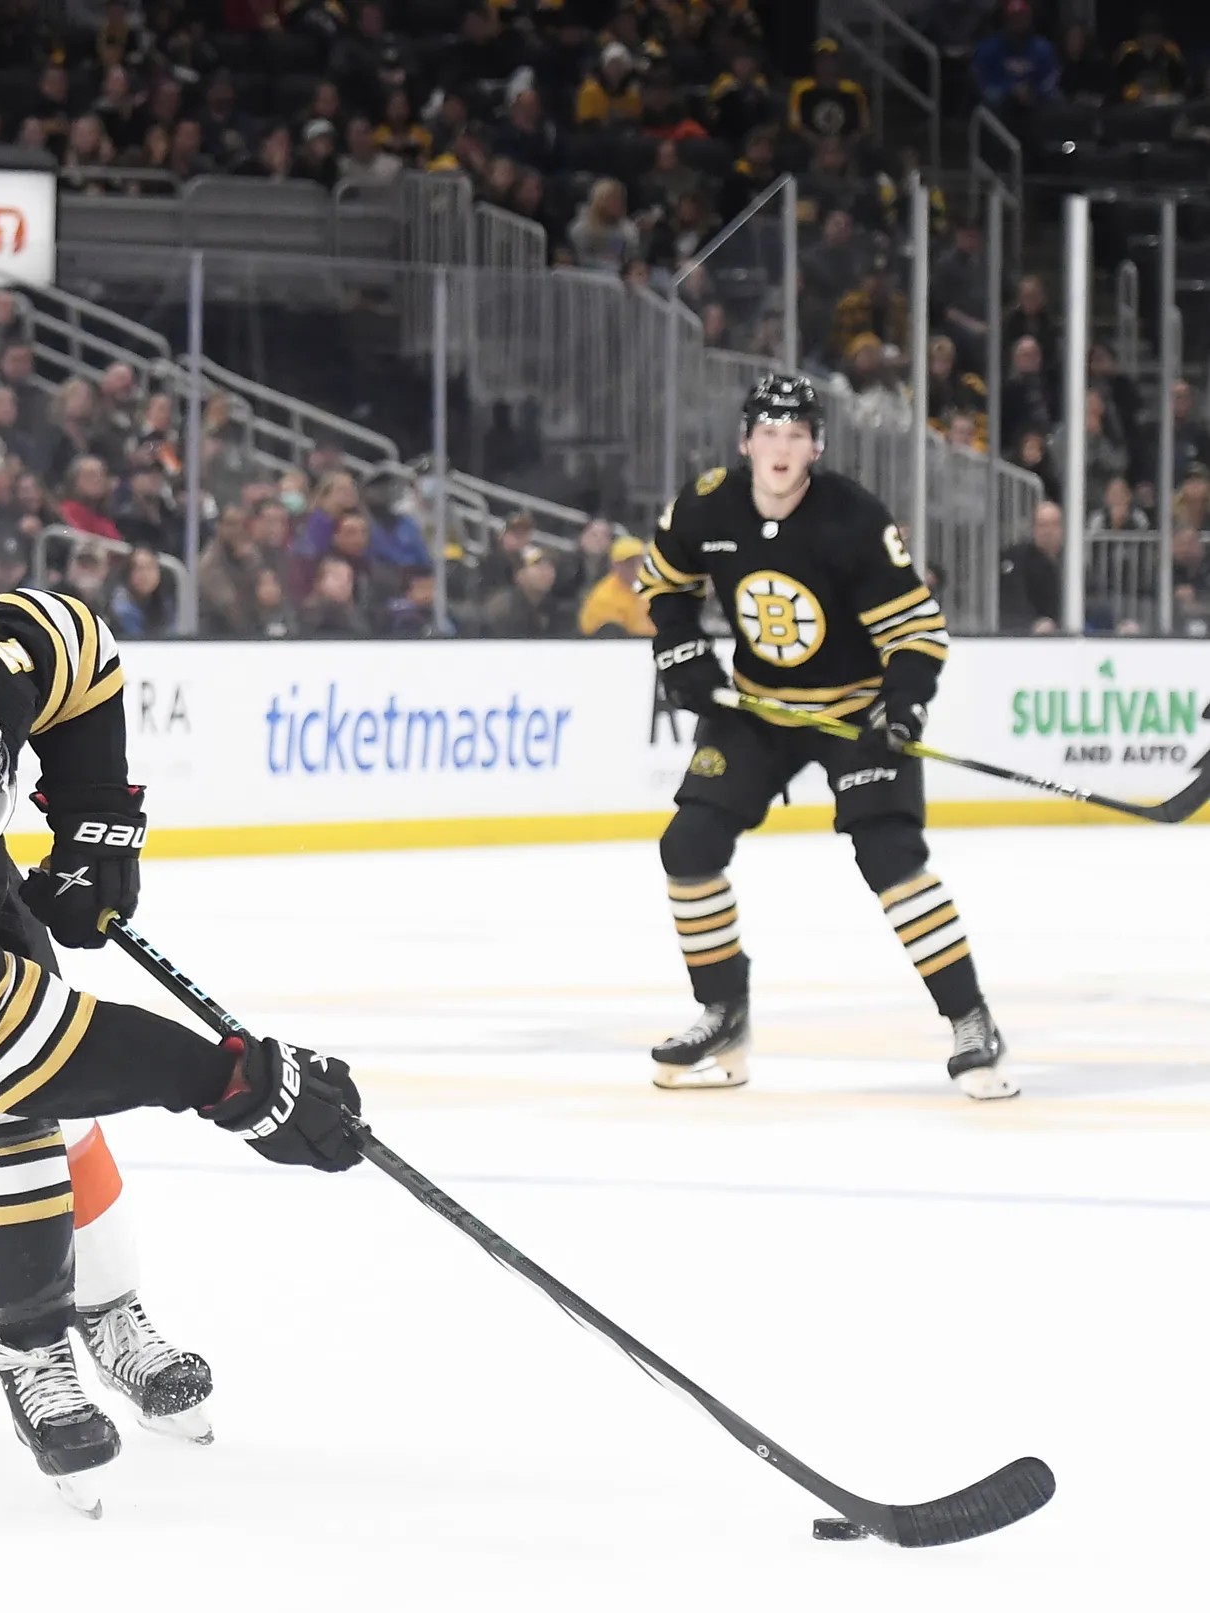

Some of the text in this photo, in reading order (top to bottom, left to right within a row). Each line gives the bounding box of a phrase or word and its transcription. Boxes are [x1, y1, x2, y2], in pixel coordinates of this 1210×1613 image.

[266, 683, 571, 774] ticketmaster
[1011, 688, 1198, 736] SULLIVAN
[1064, 744, 1187, 764] AND AUTO
[838, 767, 898, 792] CCM
